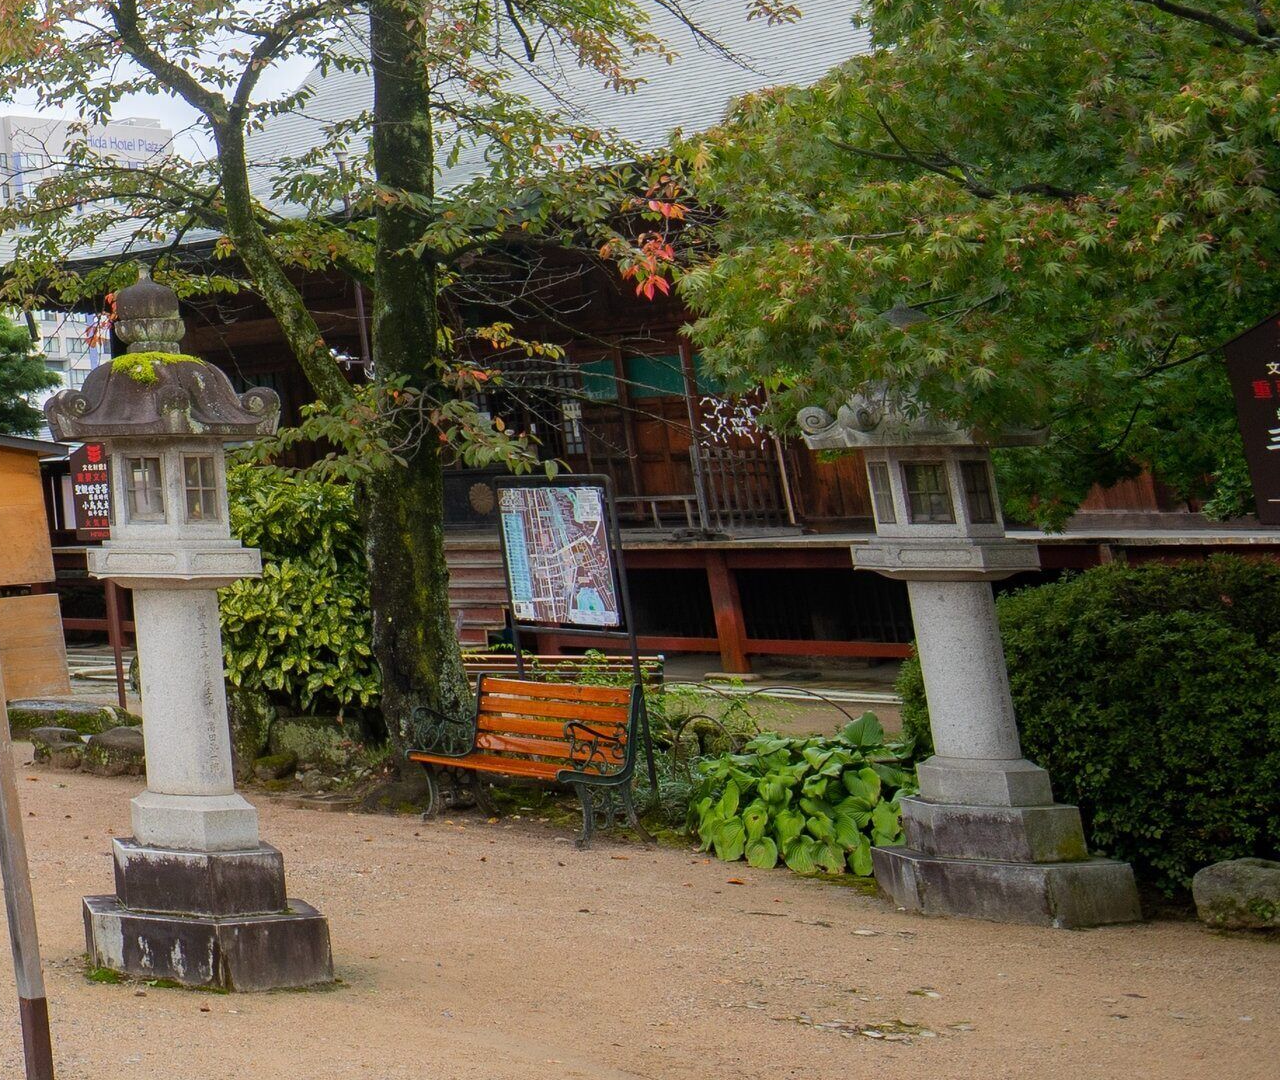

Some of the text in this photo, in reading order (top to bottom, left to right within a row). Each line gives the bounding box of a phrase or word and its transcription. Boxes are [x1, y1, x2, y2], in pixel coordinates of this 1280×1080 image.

[85, 134, 165, 153] Hida Hotel Plaza
[1253, 380, 1280, 398] 重
